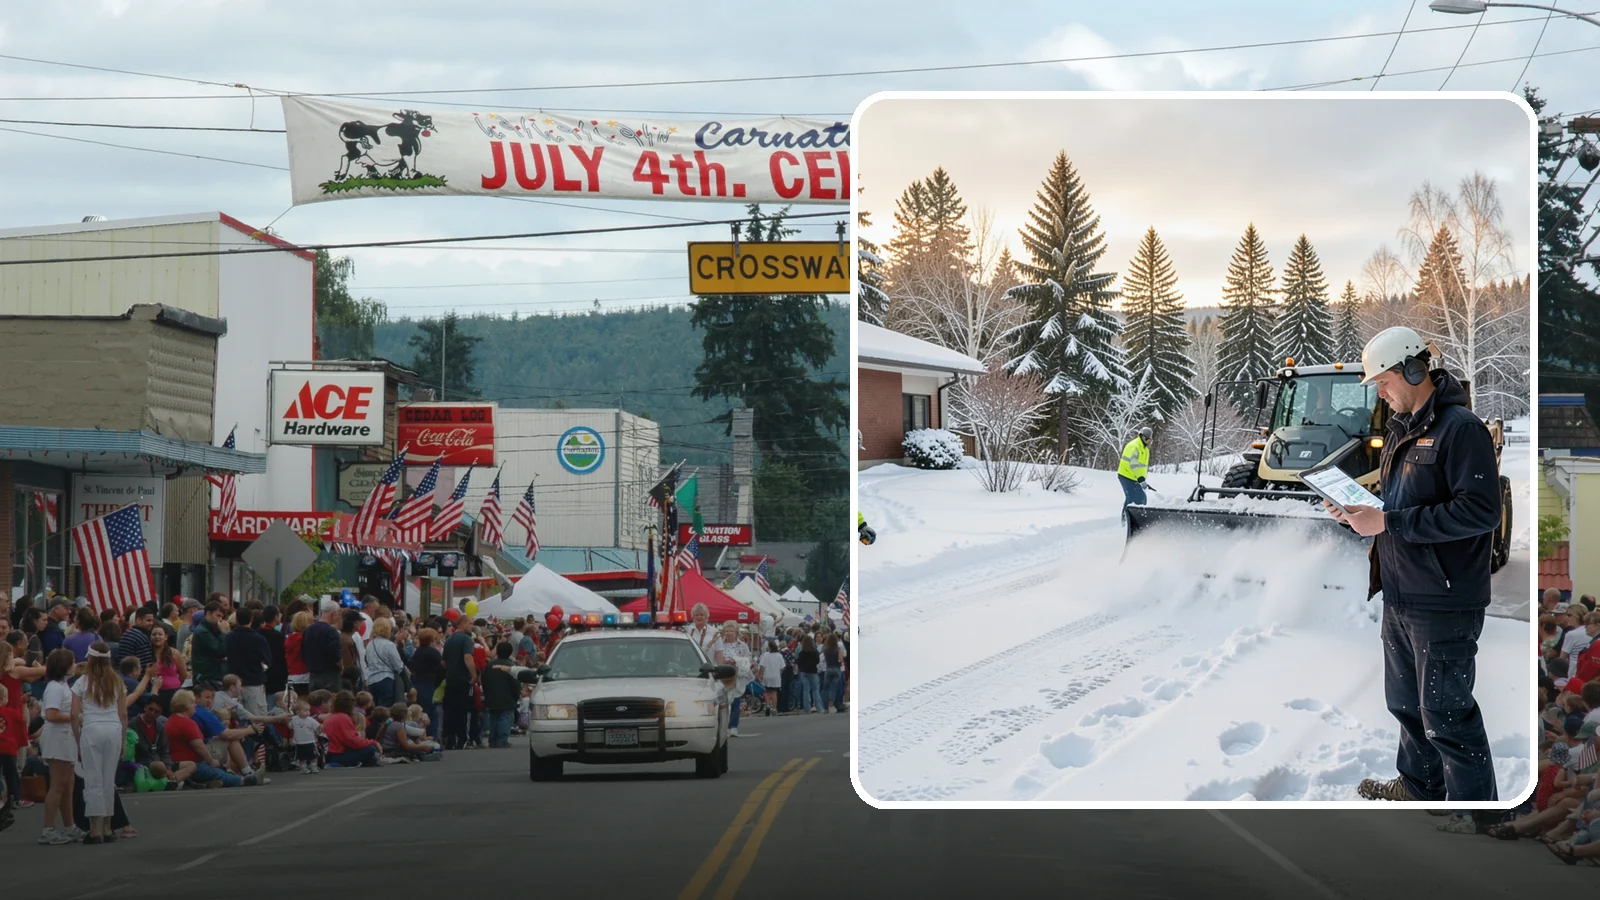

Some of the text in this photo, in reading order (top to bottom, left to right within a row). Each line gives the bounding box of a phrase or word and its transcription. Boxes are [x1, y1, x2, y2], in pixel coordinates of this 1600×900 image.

[481, 141, 605, 192] JULY
[632, 150, 746, 198] 4th.
[697, 254, 850, 279] CROSSWA
[283, 380, 373, 420] ACE
[405, 409, 485, 422] CEDAR LOG
[283, 421, 370, 436] Hardware
[416, 428, 477, 447] Coca-Cola
[353, 467, 385, 480] Simpl
[83, 486, 155, 495] St. Vincent de Paul
[688, 526, 741, 535] CRNATION
[699, 535, 730, 544] GLASS
